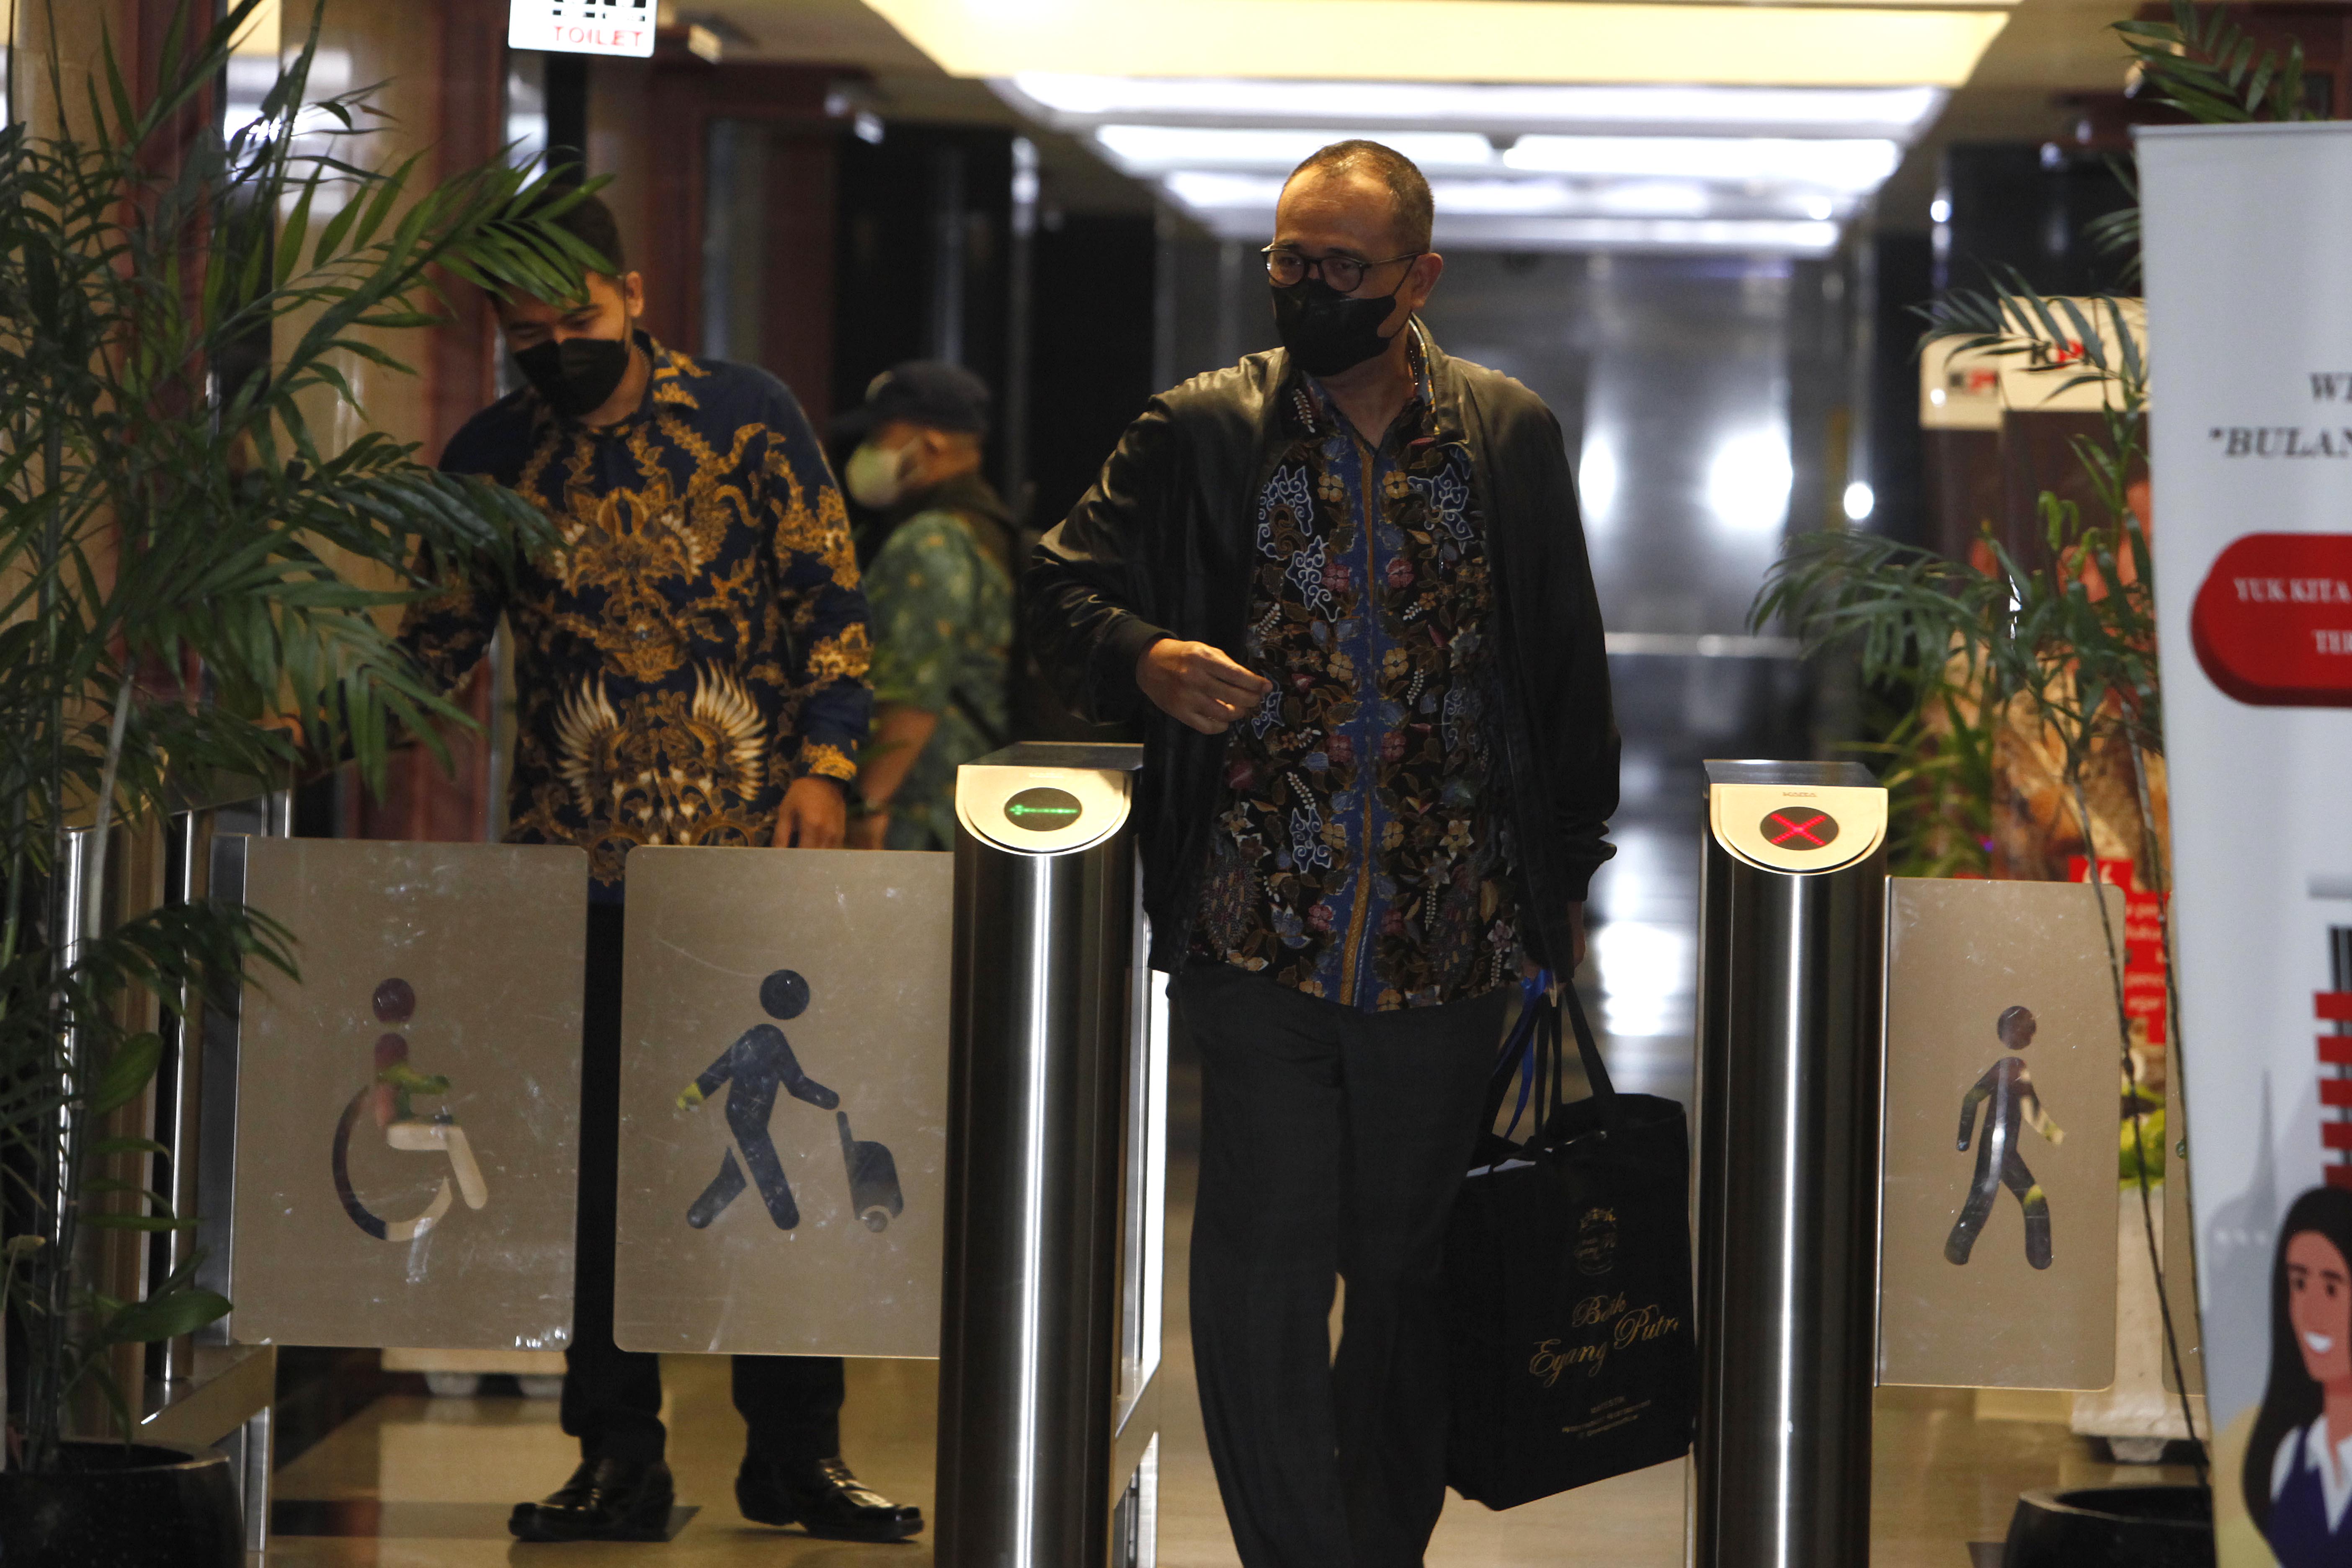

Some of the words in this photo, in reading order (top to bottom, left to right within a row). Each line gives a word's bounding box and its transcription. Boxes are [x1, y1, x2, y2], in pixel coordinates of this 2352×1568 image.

[554, 26, 643, 46] TOILET
[2309, 371, 2352, 401] W
[2233, 578, 2287, 602] YUK
